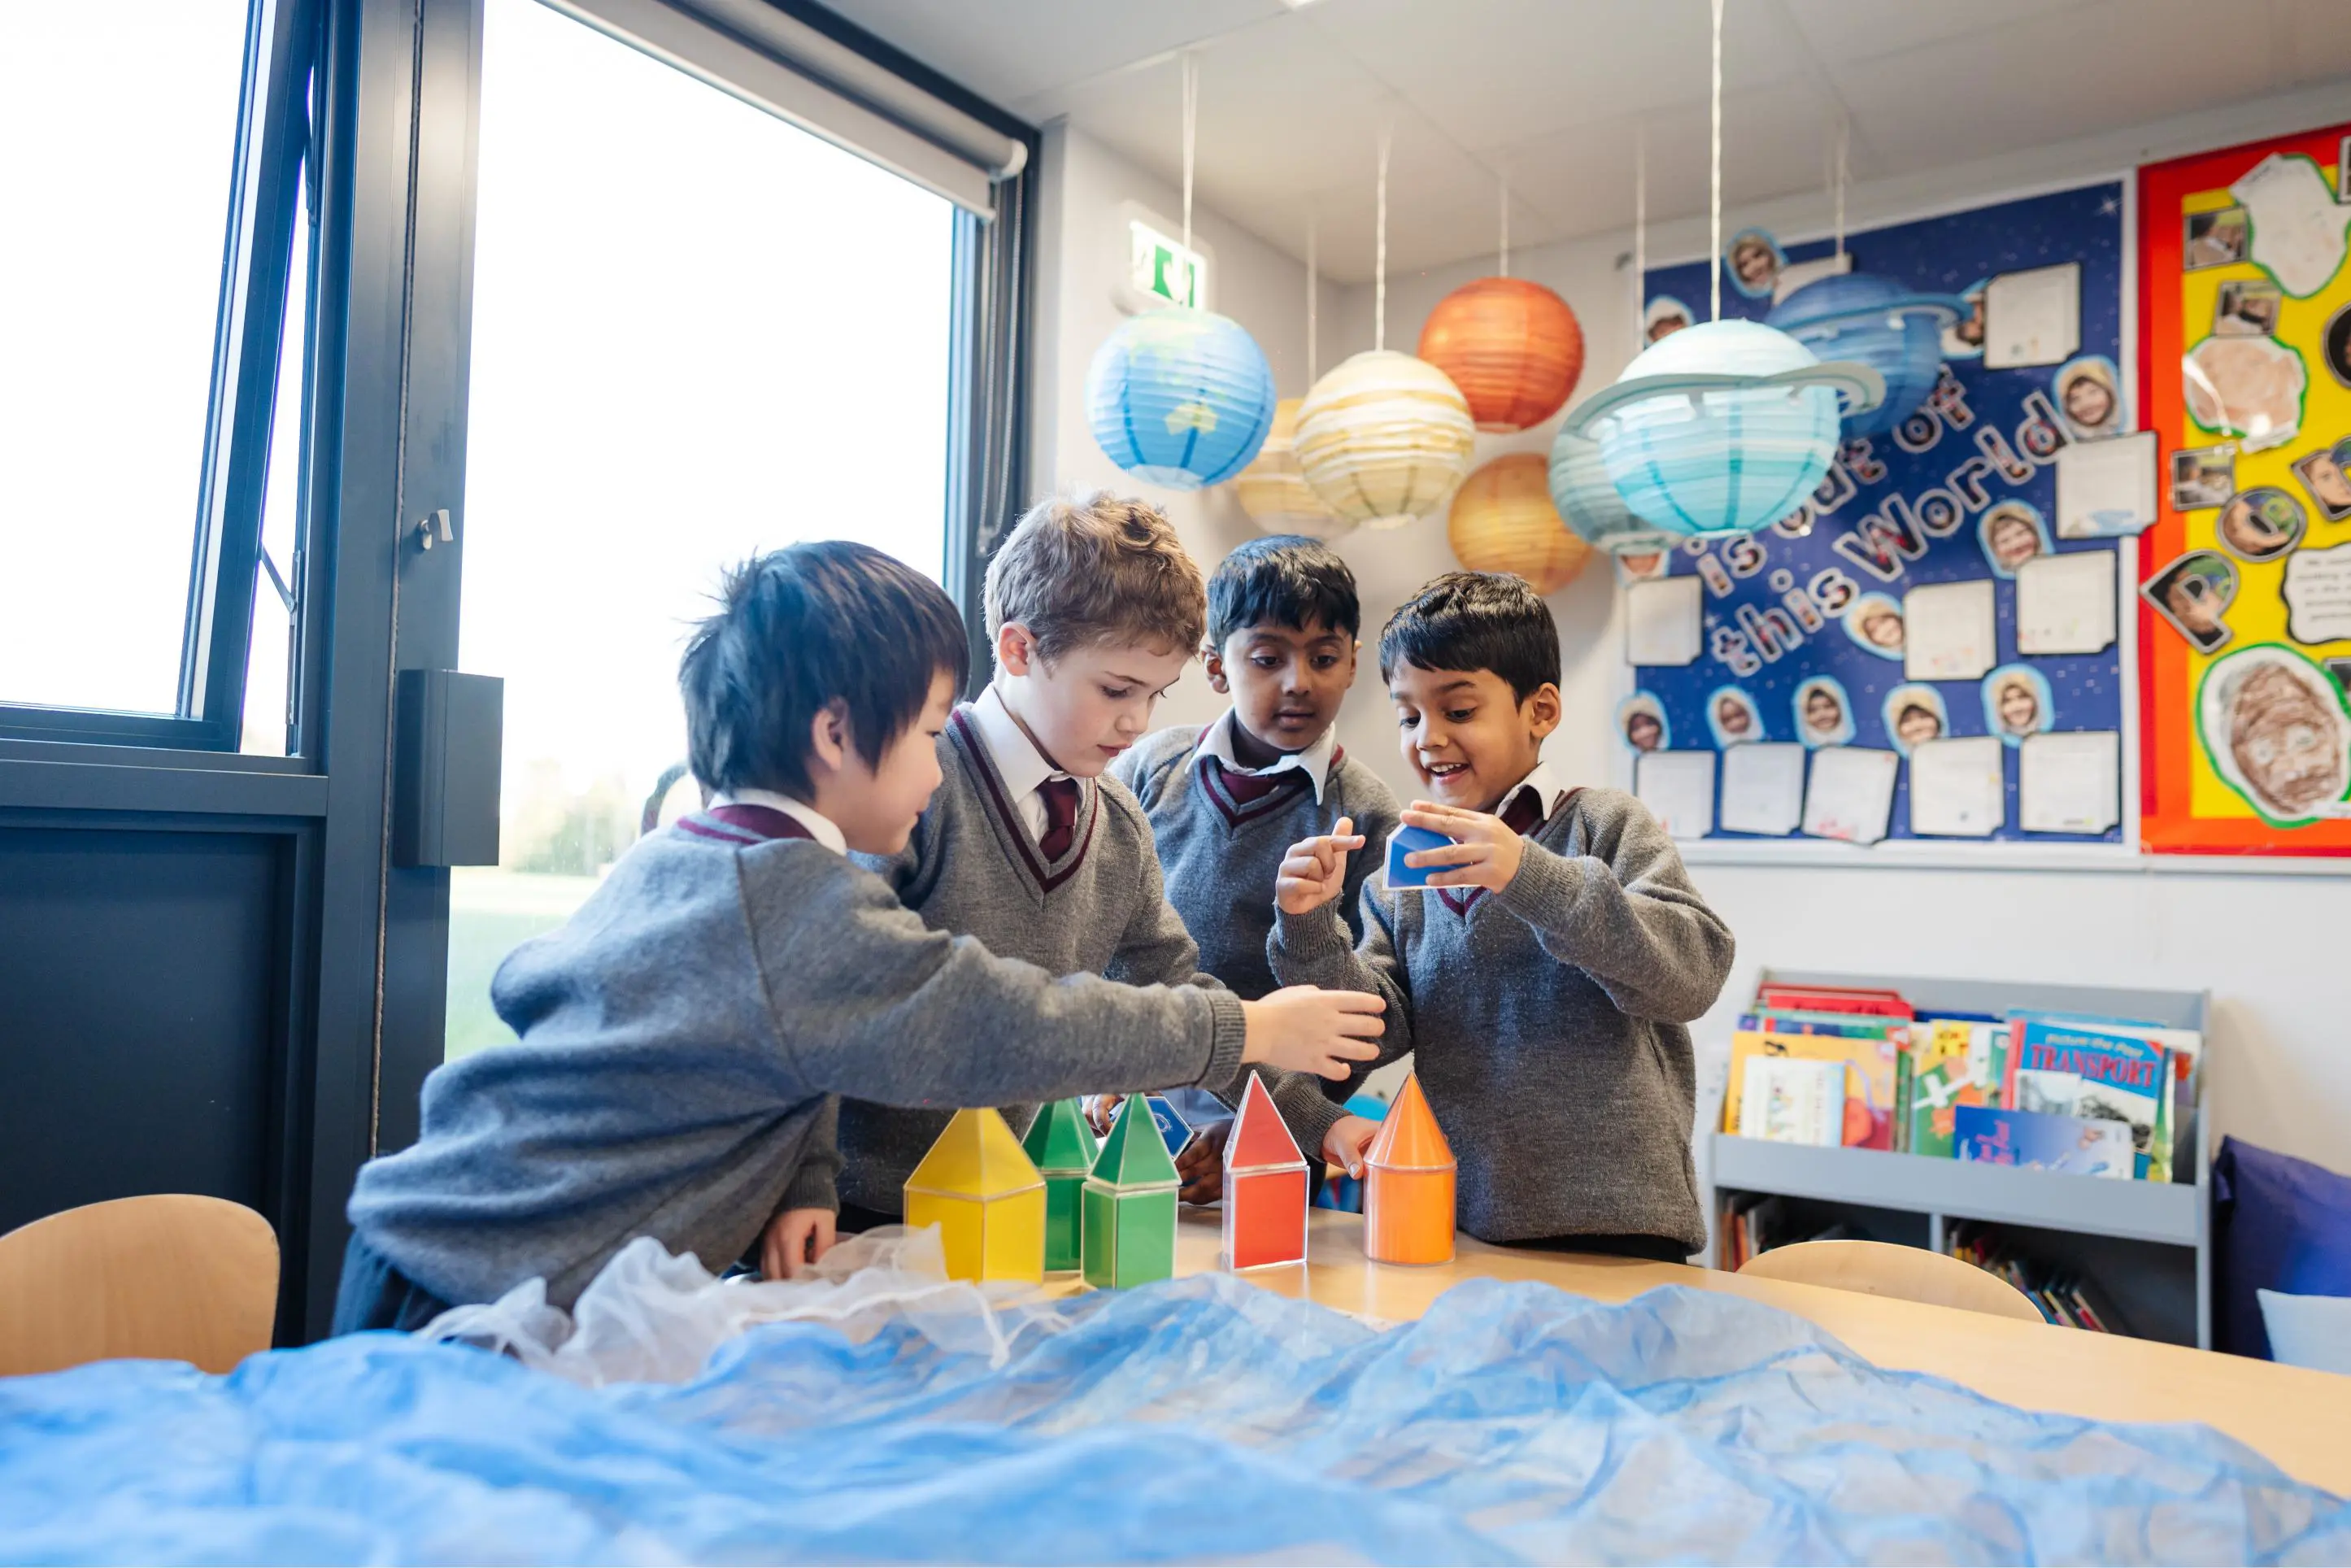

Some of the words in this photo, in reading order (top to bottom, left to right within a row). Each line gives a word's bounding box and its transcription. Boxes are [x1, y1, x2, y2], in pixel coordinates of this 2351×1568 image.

[1684, 534, 1767, 599] is
[1892, 363, 1975, 453] of
[1711, 567, 1861, 677] this
[1833, 390, 2070, 582] World
[2031, 1045, 2156, 1087] TRANSPORT
